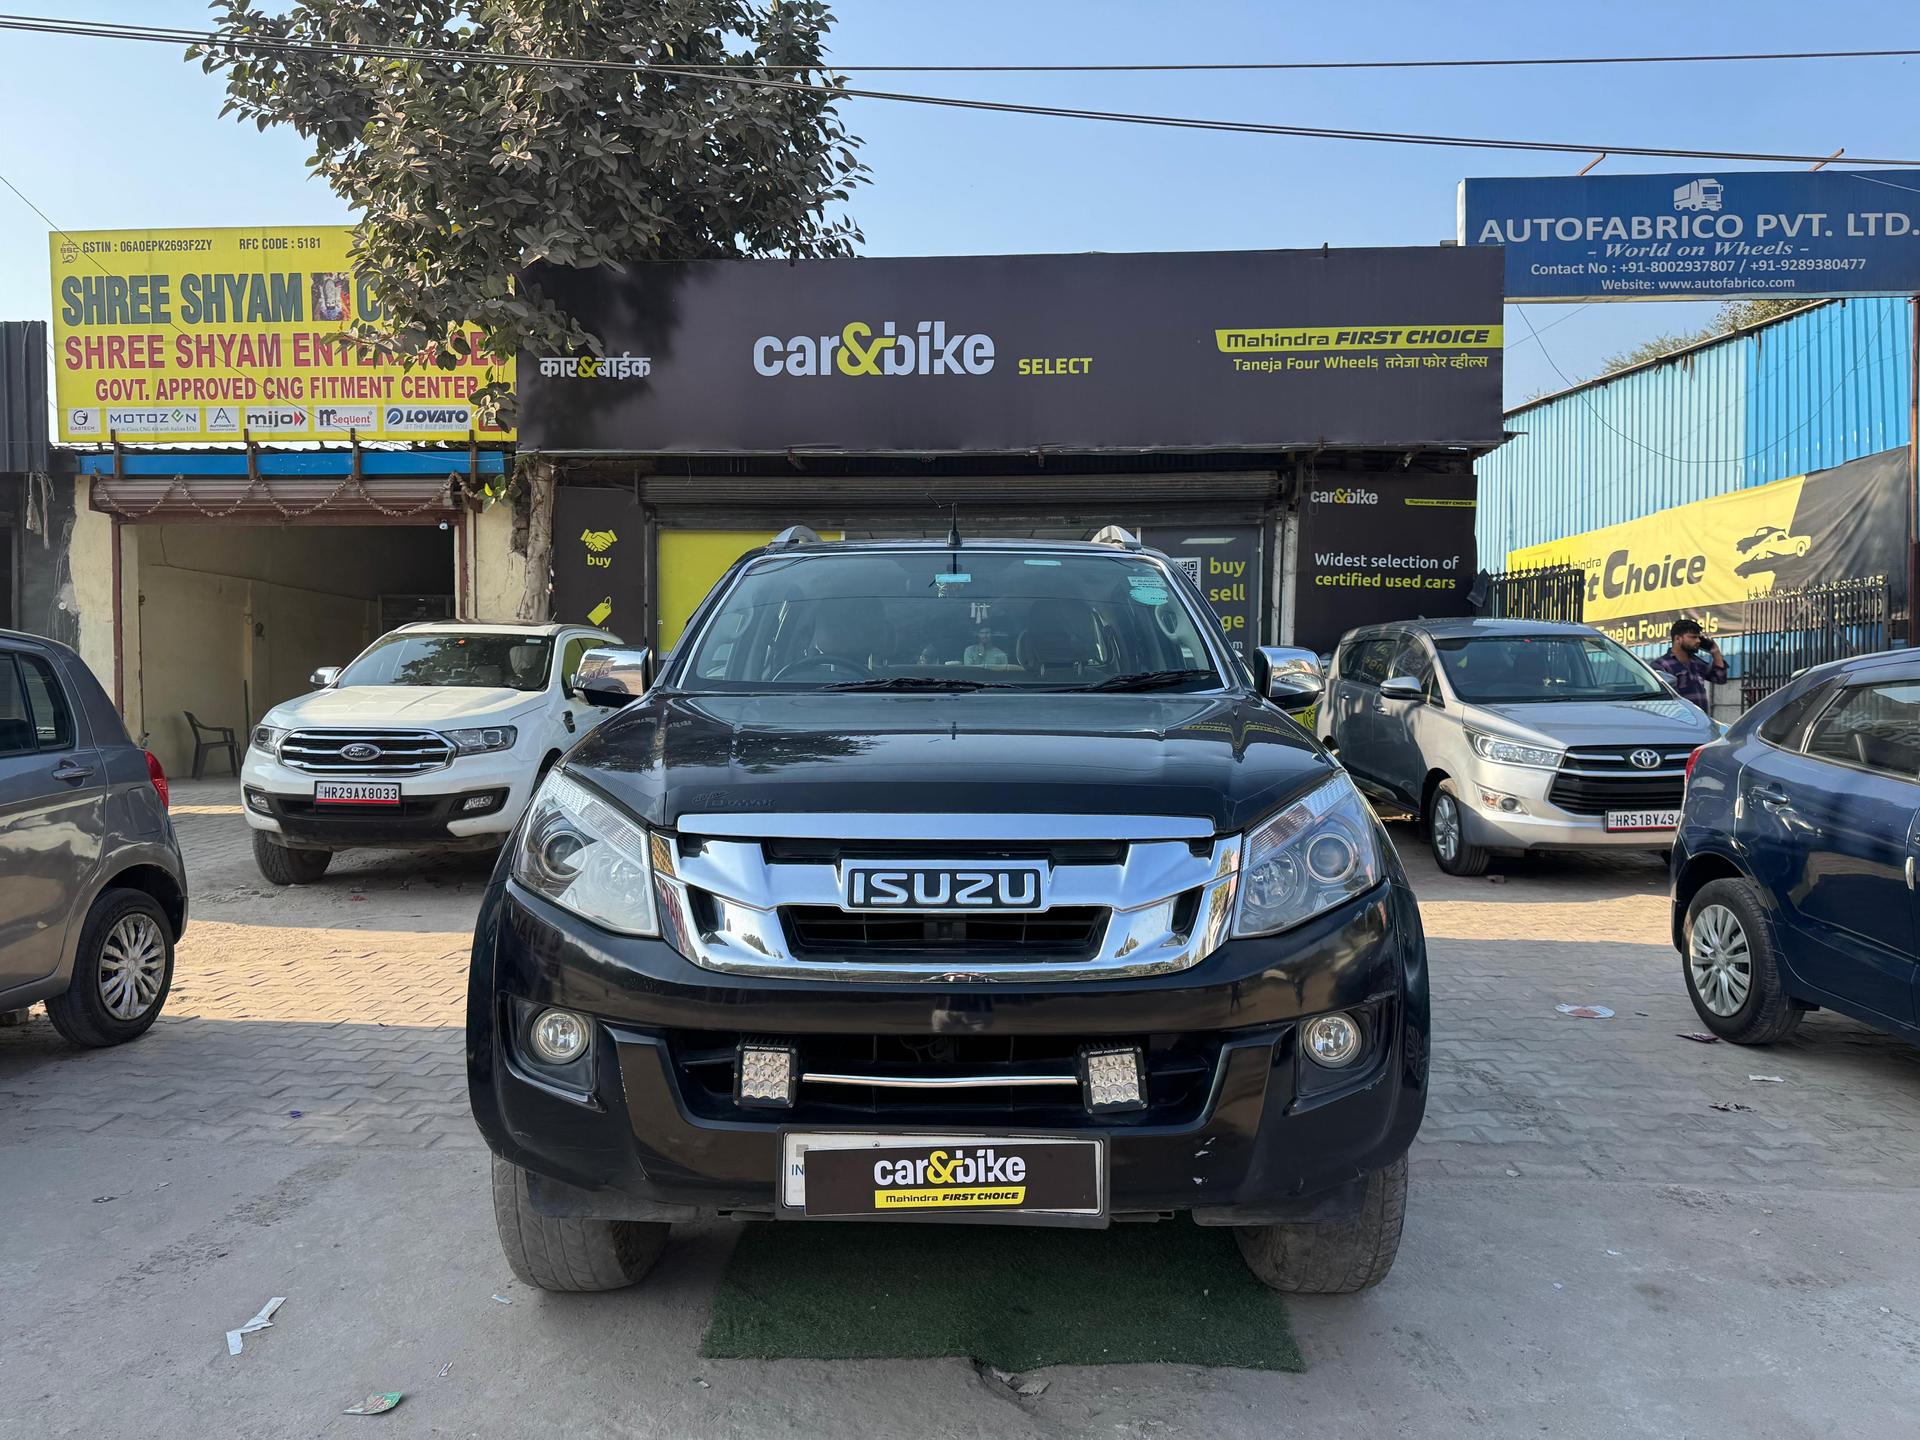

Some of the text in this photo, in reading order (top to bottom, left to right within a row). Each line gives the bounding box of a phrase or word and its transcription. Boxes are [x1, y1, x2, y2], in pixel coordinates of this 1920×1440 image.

[1478, 212, 1920, 243] AUTOFABRICO PVT. LTD.
[83, 241, 111, 253] GSTIN
[239, 238, 259, 250] RFC
[262, 237, 288, 250] CODE
[297, 237, 321, 249] 5181
[1605, 243, 1672, 258] World
[1676, 245, 1705, 256] on
[1714, 241, 1793, 256] Wheels
[1531, 262, 1584, 275] Contact
[1588, 262, 1607, 275] No
[1619, 260, 1735, 273] +91-8002937807
[1750, 258, 1866, 271] +91-9289380477
[1601, 277, 1795, 290] Website: www.autofabrico.com
[62, 274, 171, 326] SHREE
[180, 272, 304, 325] SHYAM
[1227, 329, 1489, 348] Mahindra FIRST CHOICE
[65, 334, 166, 370] SHREE
[175, 333, 281, 369] SHYAM
[753, 321, 1093, 377] car&bike SELECT
[1233, 355, 1379, 373] Taneja Four Wheels
[1384, 354, 1420, 369] तनेजा
[1422, 353, 1447, 368] फोर
[96, 376, 479, 401] GOVT. APPROVED CNG FITMENT CENTER
[247, 411, 294, 427] mijo
[405, 410, 468, 422] LOVATO
[1311, 488, 1378, 505] car&bike
[587, 554, 611, 568] buy
[1210, 557, 1246, 577] buy
[1315, 553, 1460, 570] Widest selection of
[1315, 572, 1456, 589] certified used cars
[1603, 550, 1706, 600] Choice
[1210, 584, 1245, 601] sell
[349, 747, 369, 756] Ford
[324, 786, 397, 799] HR29AX8033
[853, 872, 1035, 905] ISUZU
[874, 1149, 1026, 1186] car&bike
[886, 1191, 1019, 1203] Mahindra FIRST CHOICE
